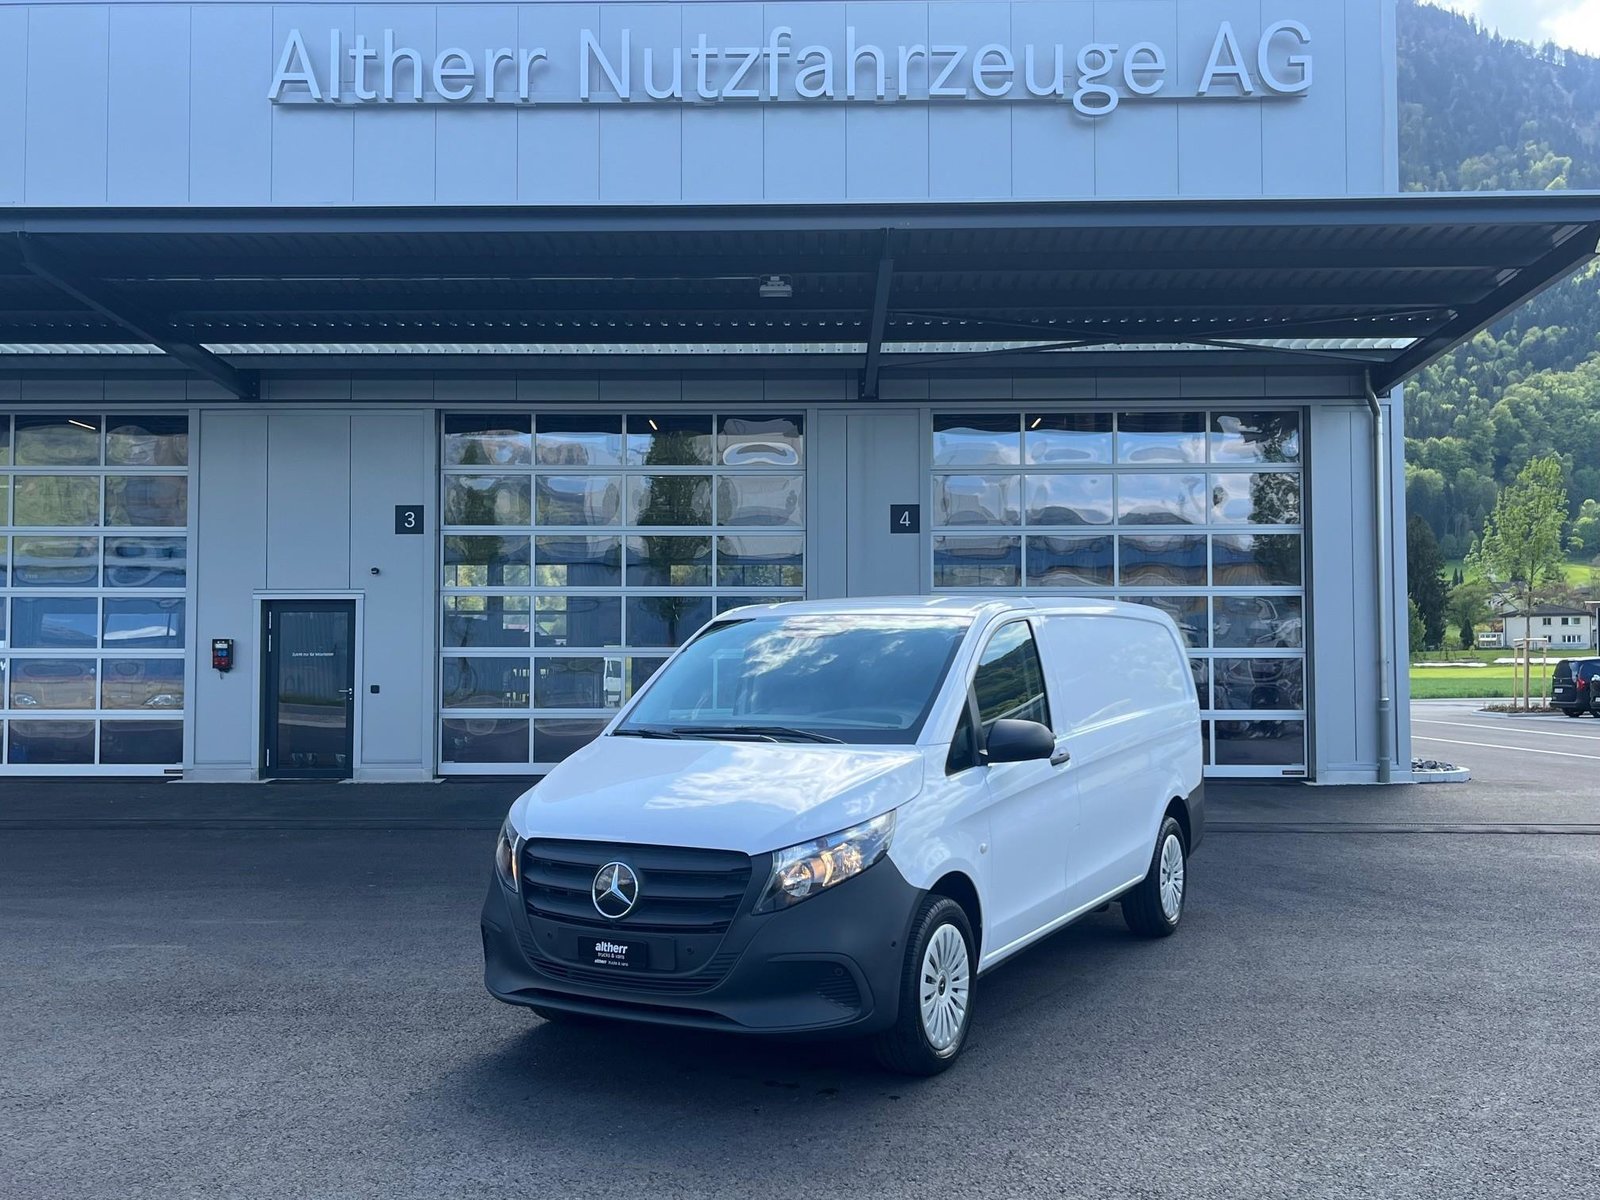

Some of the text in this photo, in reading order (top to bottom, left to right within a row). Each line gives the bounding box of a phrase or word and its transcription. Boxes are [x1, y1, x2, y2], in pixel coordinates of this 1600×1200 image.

[267, 19, 1314, 118] Altherr Nutzfahrzeuge AG
[404, 511, 415, 528] 3
[899, 511, 911, 527] 4
[595, 941, 628, 954] altherr
